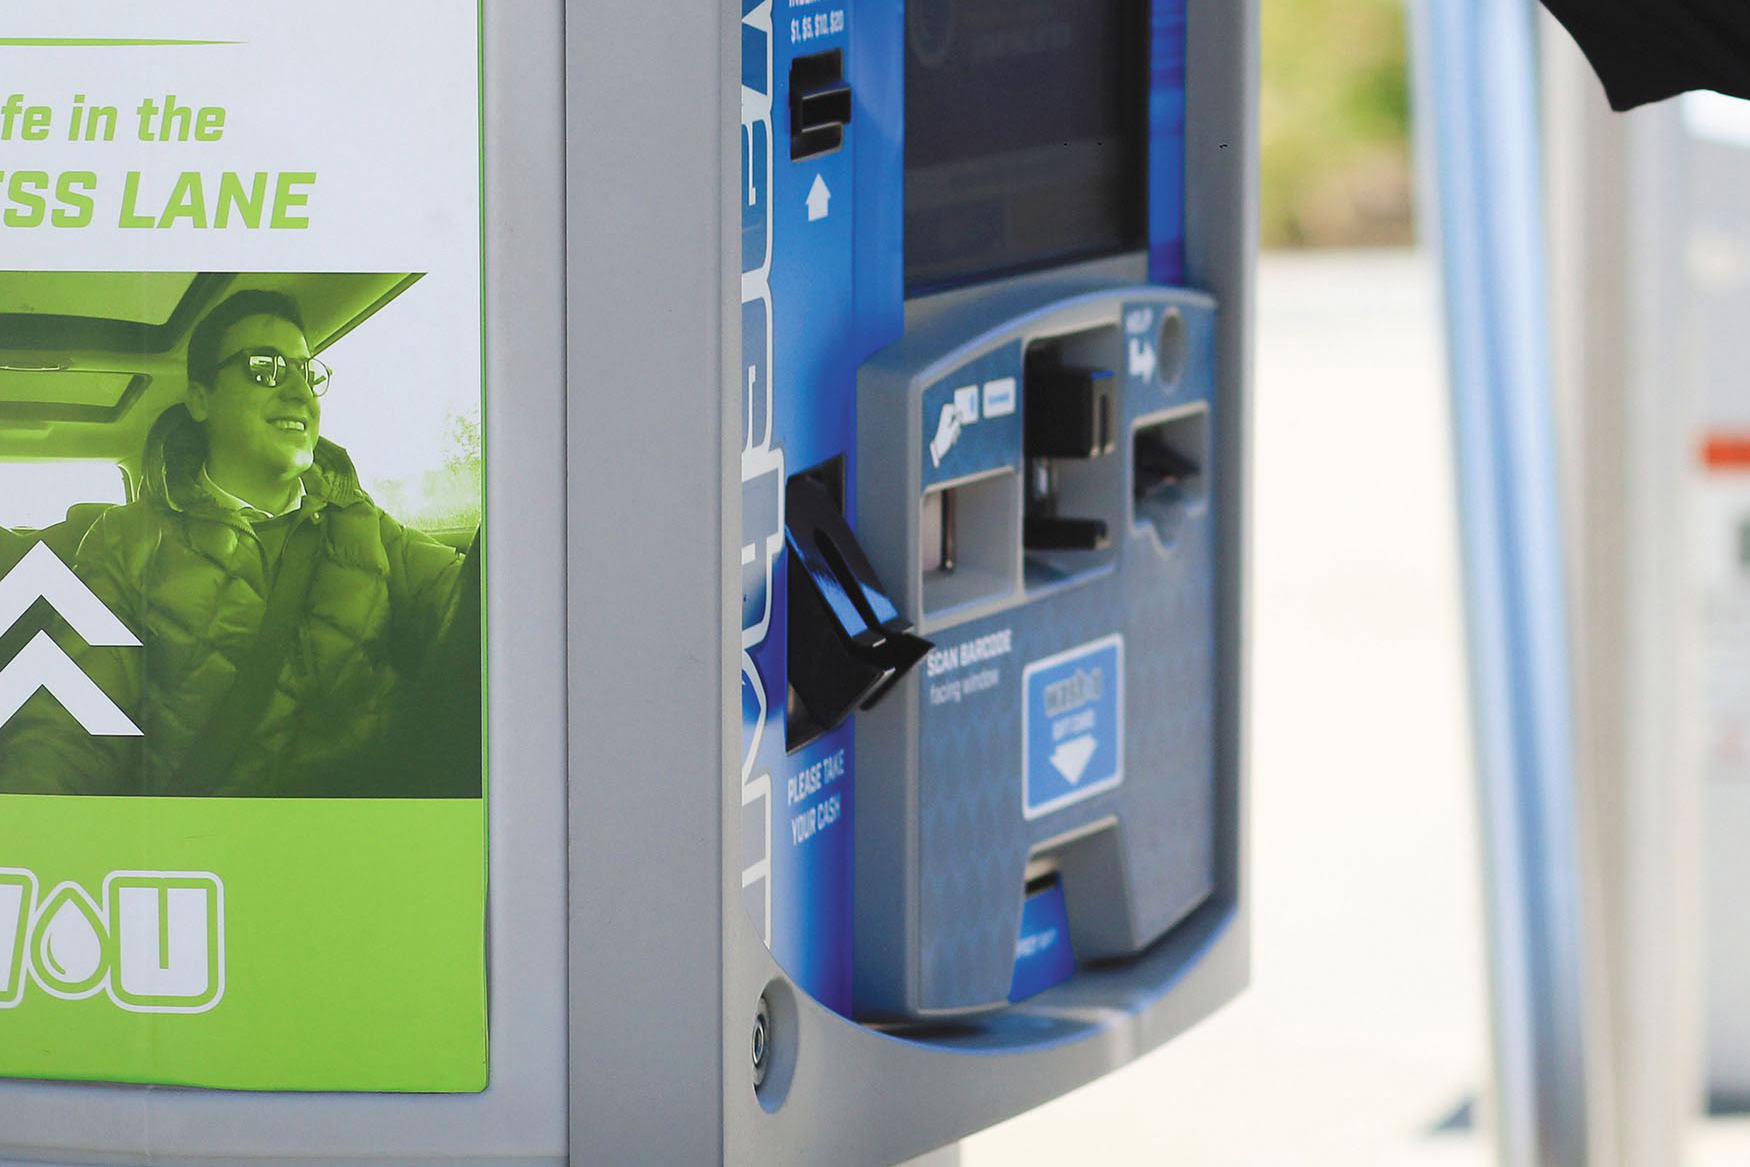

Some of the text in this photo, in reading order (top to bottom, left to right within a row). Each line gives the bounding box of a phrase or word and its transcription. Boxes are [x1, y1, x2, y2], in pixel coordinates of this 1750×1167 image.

[67, 94, 118, 142] in
[136, 94, 227, 143] the
[0, 170, 317, 230] SS LANE
[926, 629, 1012, 677] SCAN BARCODE
[930, 669, 999, 706] facing window
[787, 749, 845, 806] PLEASE TAKE
[791, 794, 842, 846] YOUR CASH
